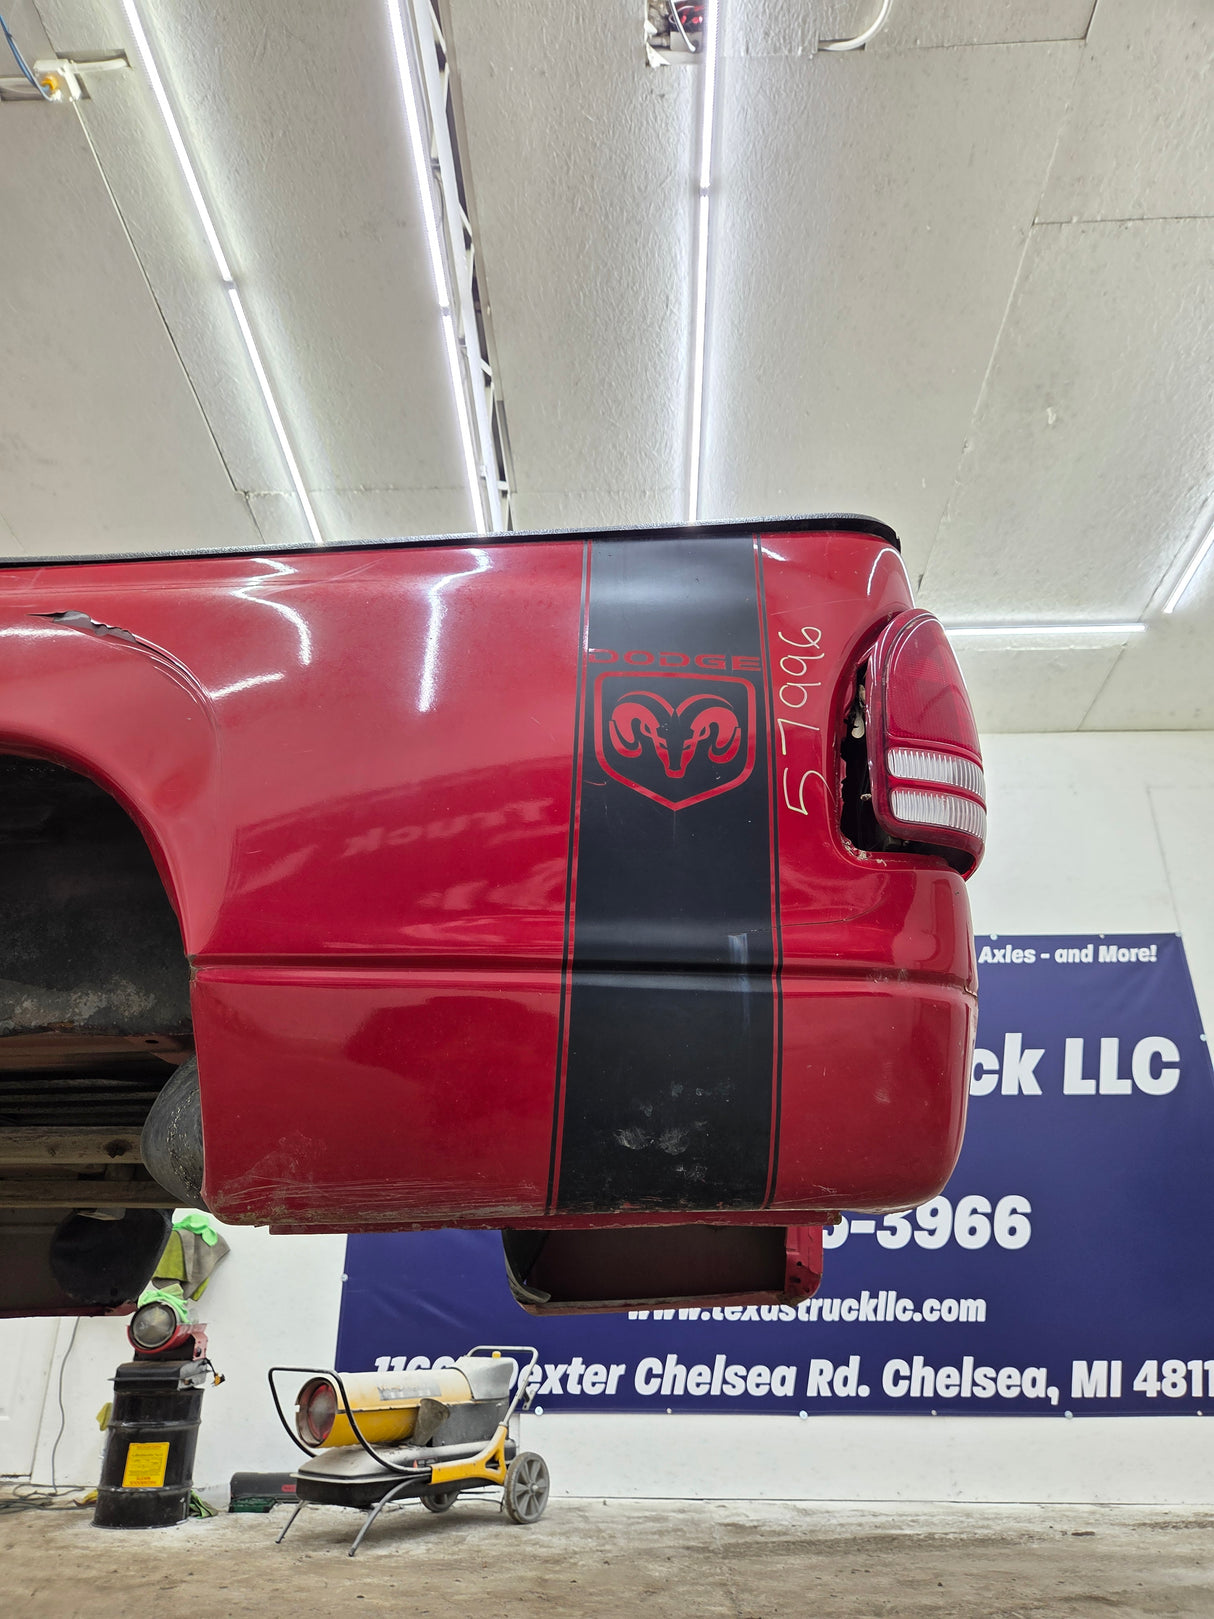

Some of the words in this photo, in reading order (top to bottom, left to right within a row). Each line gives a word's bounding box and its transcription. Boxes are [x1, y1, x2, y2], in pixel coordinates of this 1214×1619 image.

[588, 648, 761, 672] DODGE
[777, 625, 831, 816] 57996
[978, 944, 1036, 964] Axles
[1054, 943, 1094, 964] and
[1097, 944, 1158, 964] More!
[1062, 1036, 1181, 1096] LLC
[634, 1354, 798, 1397] Chelsea
[806, 1355, 871, 1398] Rd.
[882, 1355, 1060, 1406] Chelsea,
[1070, 1360, 1123, 1399] MI
[1132, 1359, 1214, 1398] 4811
